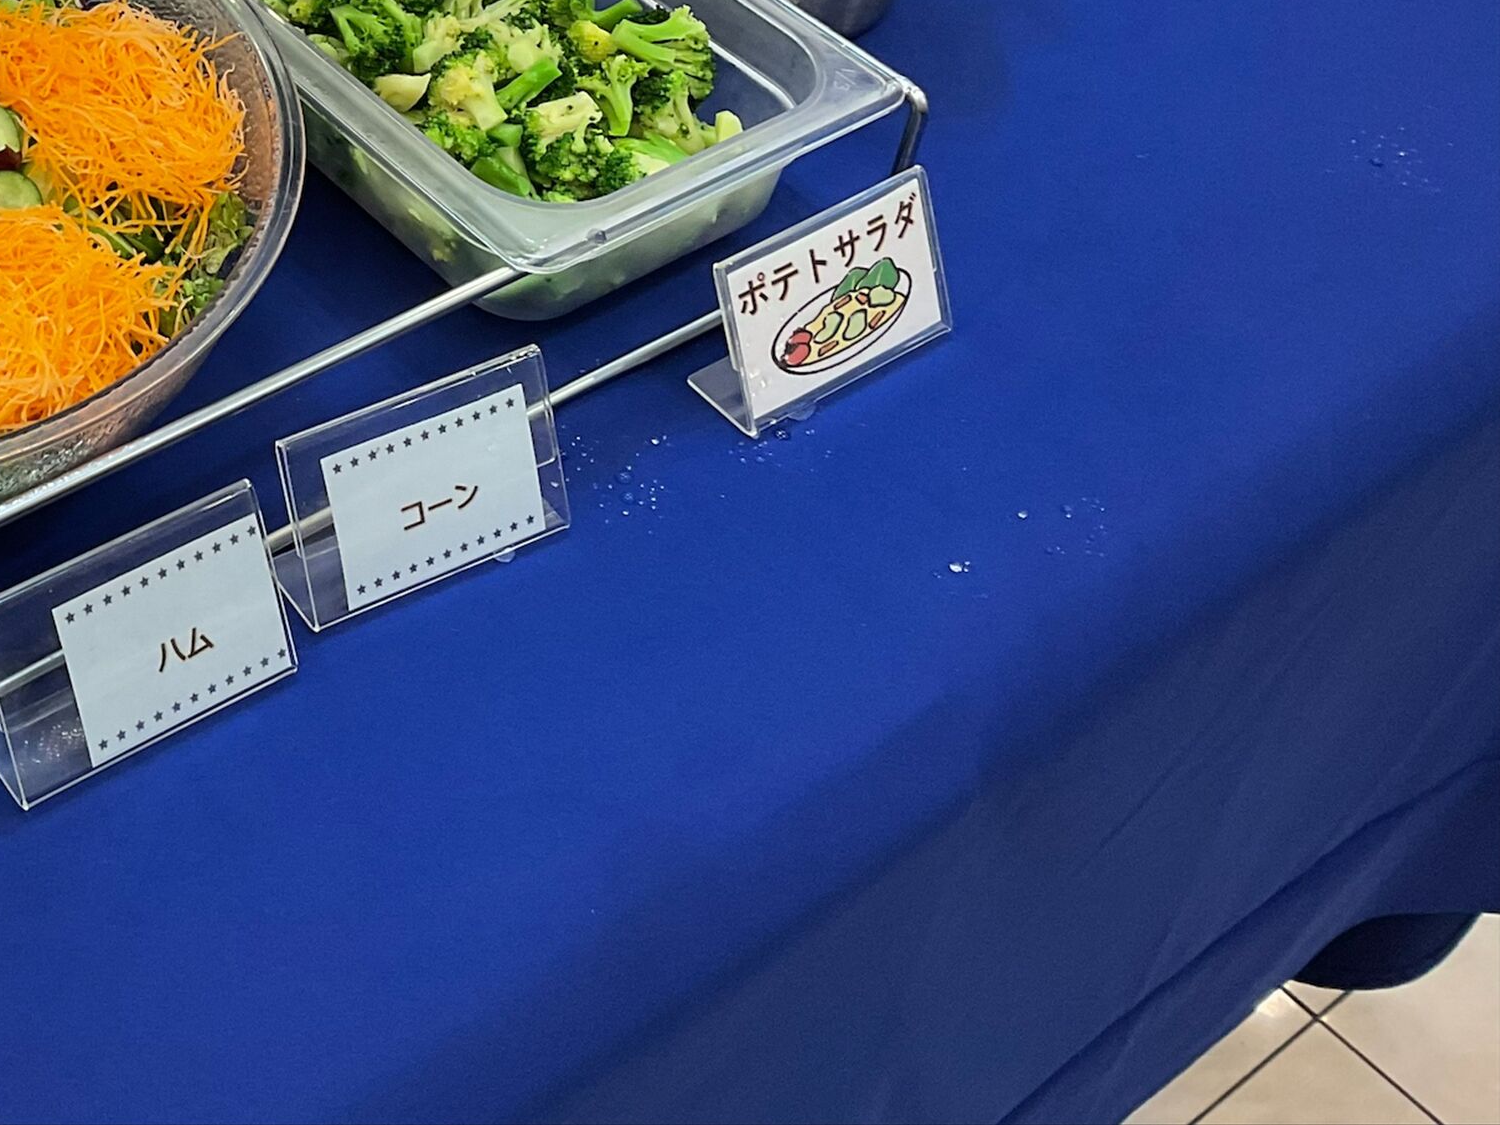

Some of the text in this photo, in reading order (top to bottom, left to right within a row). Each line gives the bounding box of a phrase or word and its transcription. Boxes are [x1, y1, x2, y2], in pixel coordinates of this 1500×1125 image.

[738, 192, 918, 316] ポテトサラダ
[400, 484, 479, 532] コーン
[158, 627, 215, 673] ハム
